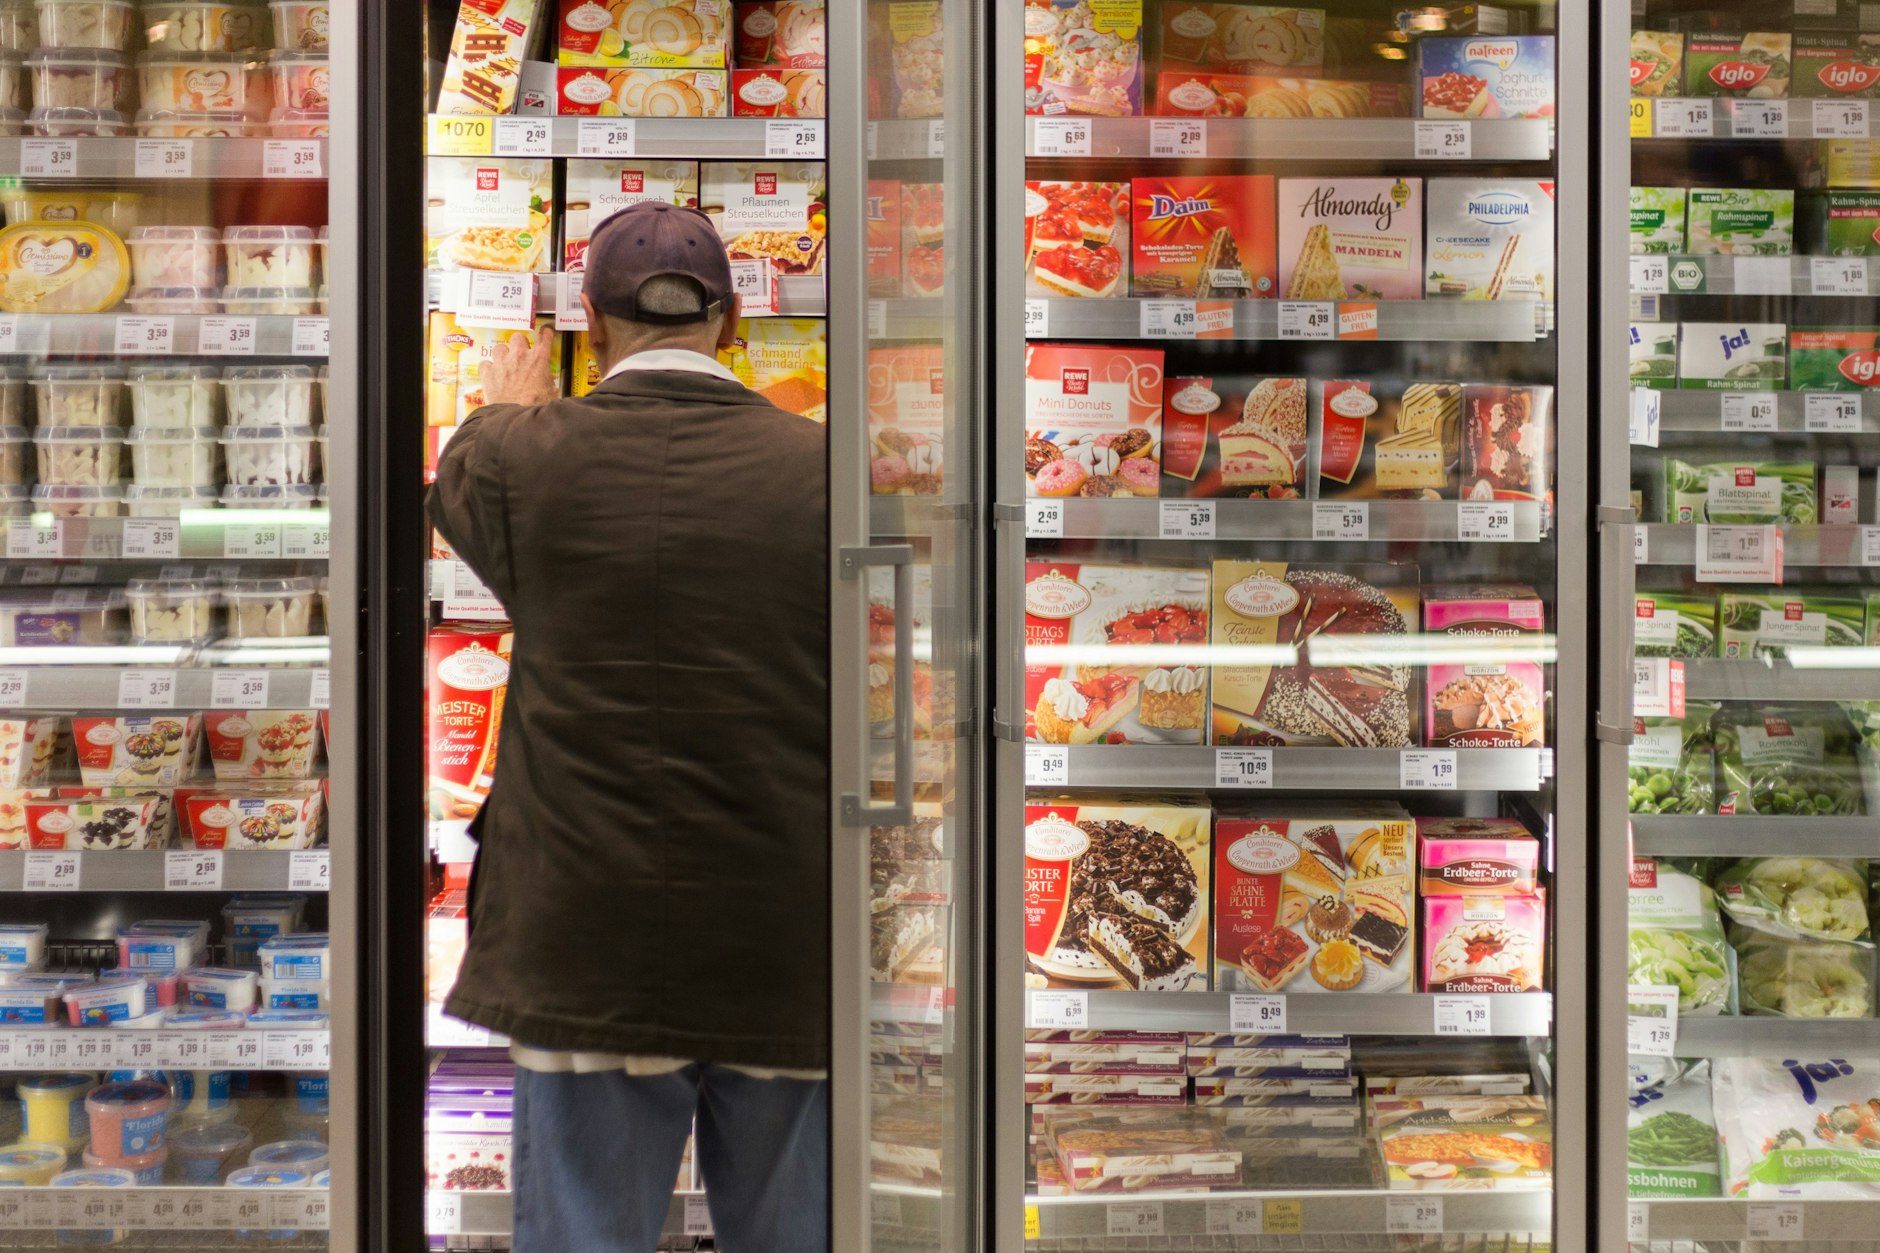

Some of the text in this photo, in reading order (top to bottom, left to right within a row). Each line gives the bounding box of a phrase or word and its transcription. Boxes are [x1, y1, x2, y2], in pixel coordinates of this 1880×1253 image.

[1796, 36, 1848, 47] Blatt-Spinat
[1468, 44, 1515, 57] natreen
[630, 52, 676, 66] Zitrone
[1497, 72, 1544, 88] Joghurt
[1720, 65, 1755, 84] iglo
[1830, 66, 1867, 86] iglo
[1496, 86, 1547, 100] Schnitte
[444, 122, 485, 137] 1070
[755, 175, 776, 183] REWE
[474, 192, 501, 204] Apfel
[742, 197, 790, 208] Pflaumen
[1722, 193, 1751, 206] Bio
[1151, 195, 1210, 219] Daim
[1298, 186, 1402, 231] Almondy
[1469, 202, 1529, 216] PHILADELPHIA
[727, 208, 804, 219] Streuselkuchen
[1717, 212, 1768, 223] Rahmspinat
[19, 247, 70, 263] Cremissimo
[1335, 245, 1402, 259] MANDELN
[1197, 309, 1231, 323] GLUTEN-
[1341, 311, 1376, 325] GLUTEN-
[1207, 320, 1225, 330] FREI
[1351, 322, 1369, 332] FREI
[1720, 328, 1751, 361] ja!
[750, 348, 801, 359] schmand
[755, 358, 816, 370] mandarine
[1852, 355, 1880, 375] igl
[1064, 372, 1087, 380] REWE
[1707, 380, 1760, 390] Rahm-Spinat
[1038, 398, 1112, 411] Mini Donuts
[1736, 468, 1754, 476] REWE
[1718, 488, 1771, 500] Blattspinat
[1243, 583, 1281, 593] Conditorei
[1228, 594, 1268, 613] Coppenrath
[1274, 597, 1294, 611] Wiese
[1223, 622, 1265, 638] Feinste
[1447, 627, 1520, 639] Schoko-Torte
[1766, 622, 1820, 632] Junger Spinat
[1223, 674, 1262, 683] Kirsch-Torte
[431, 700, 487, 718] MEISTER
[443, 716, 474, 727] TORTE
[446, 729, 478, 740] Mandel
[433, 739, 482, 753] Bienen-
[1448, 737, 1521, 748] Schoko-Torte
[1759, 738, 1808, 749] Rosenkohl
[441, 752, 469, 767] stich
[1239, 761, 1267, 775] 10.49
[1383, 824, 1404, 836] NEU
[1246, 839, 1283, 849] Conditorei
[1231, 850, 1272, 869] Coppenrath
[1471, 861, 1491, 869] Sahne
[1443, 868, 1518, 878] Erdbeer-Torte
[1236, 878, 1260, 886] BUNTE
[1230, 885, 1265, 897] SAHNE
[1229, 896, 1266, 909] PLATTE
[1028, 914, 1041, 924] Split
[1231, 923, 1261, 934] Auslese
[1472, 977, 1494, 985] Sahne
[1445, 982, 1521, 993] Erdbeer-Torte
[1782, 1058, 1854, 1106] ja!
